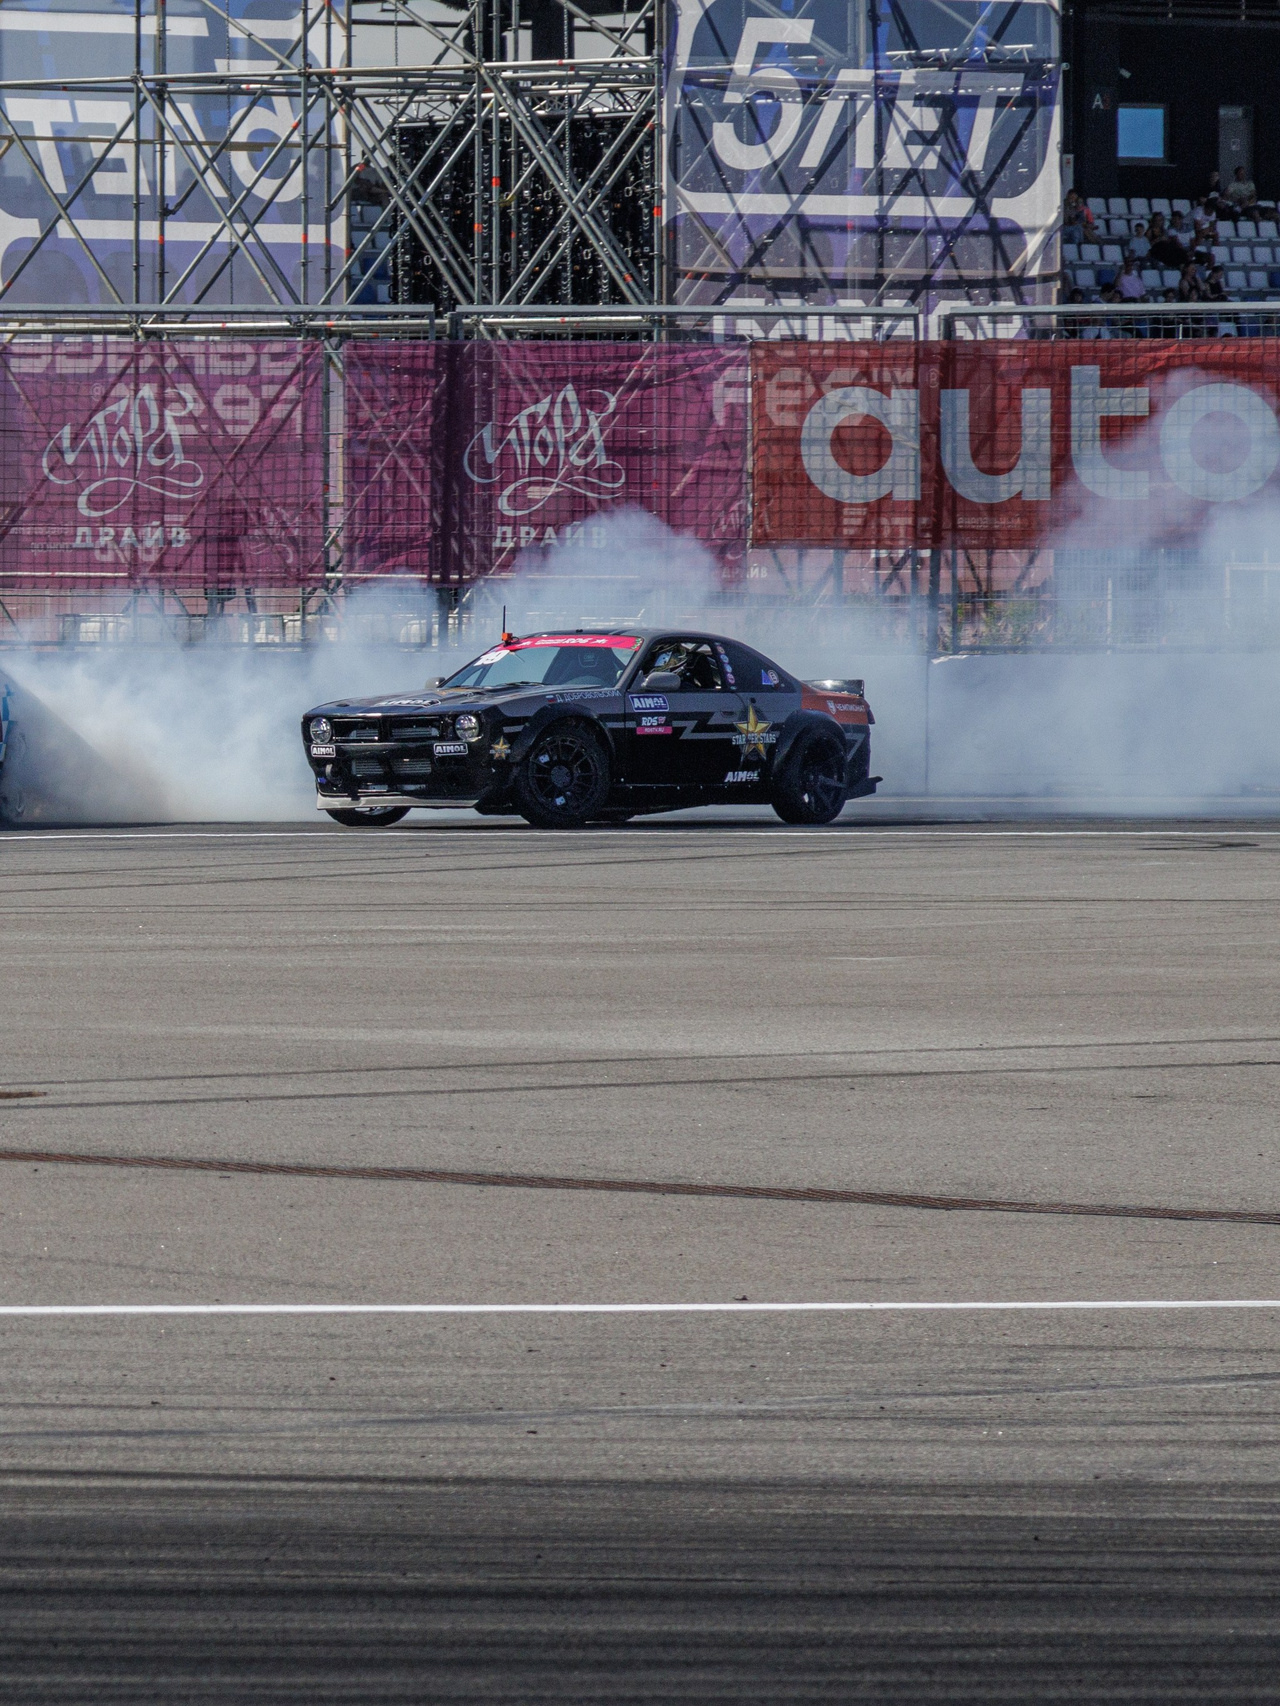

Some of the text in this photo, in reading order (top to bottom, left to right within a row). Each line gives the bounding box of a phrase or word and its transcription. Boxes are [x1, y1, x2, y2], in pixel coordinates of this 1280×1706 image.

[713, 17, 1025, 171] 5 ЛЕТ
[801, 365, 1280, 503] auto
[73, 520, 187, 548] ДРАЙВ
[492, 522, 607, 548] ДРАЙВ
[632, 697, 667, 709] AIMOL
[641, 716, 658, 726] RDS
[312, 747, 334, 755] AIMOL
[435, 745, 466, 754] AIMOL
[724, 770, 760, 783] AIMOL
